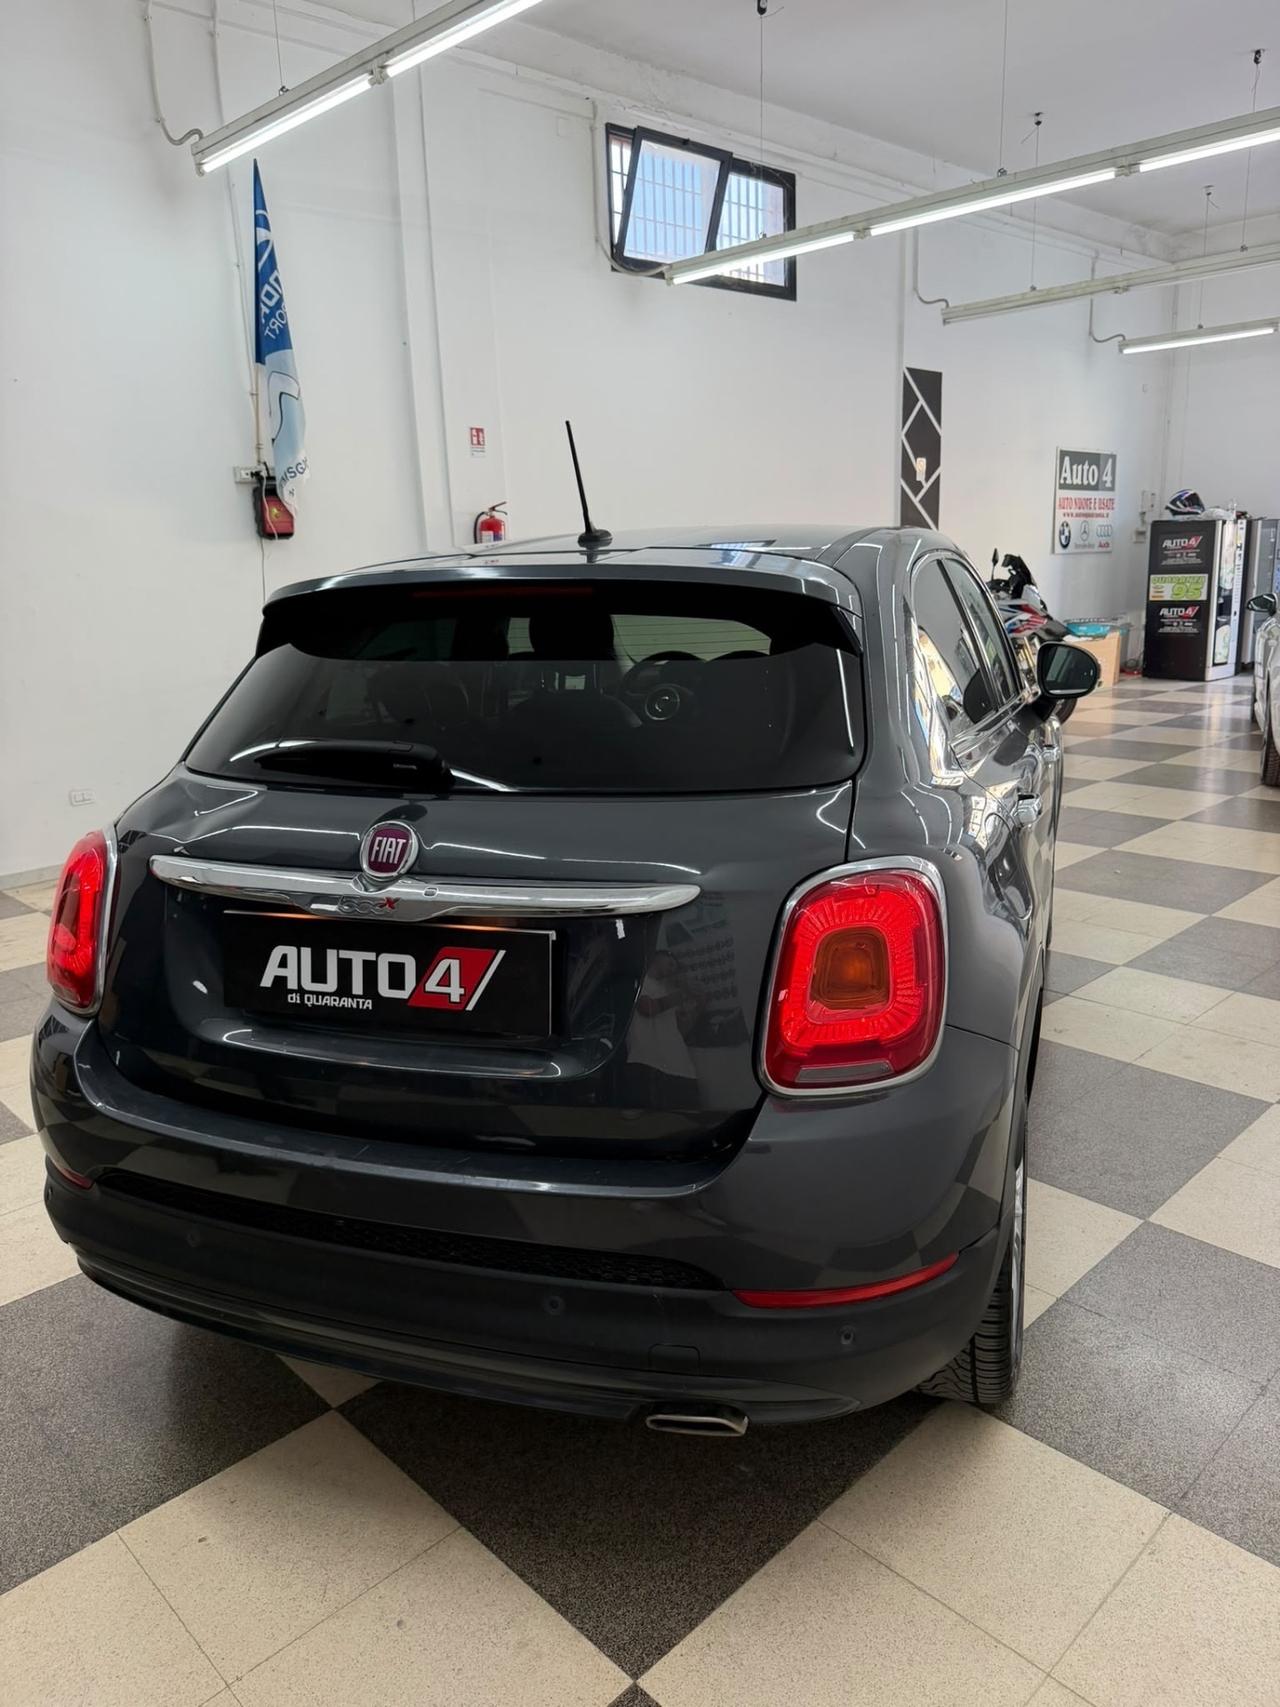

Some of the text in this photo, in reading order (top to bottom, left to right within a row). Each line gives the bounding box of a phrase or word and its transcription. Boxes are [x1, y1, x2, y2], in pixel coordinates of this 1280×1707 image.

[1060, 455, 1113, 488] Auto 4
[371, 836, 407, 864] FIAT
[287, 992, 373, 1010] di QUARANTA
